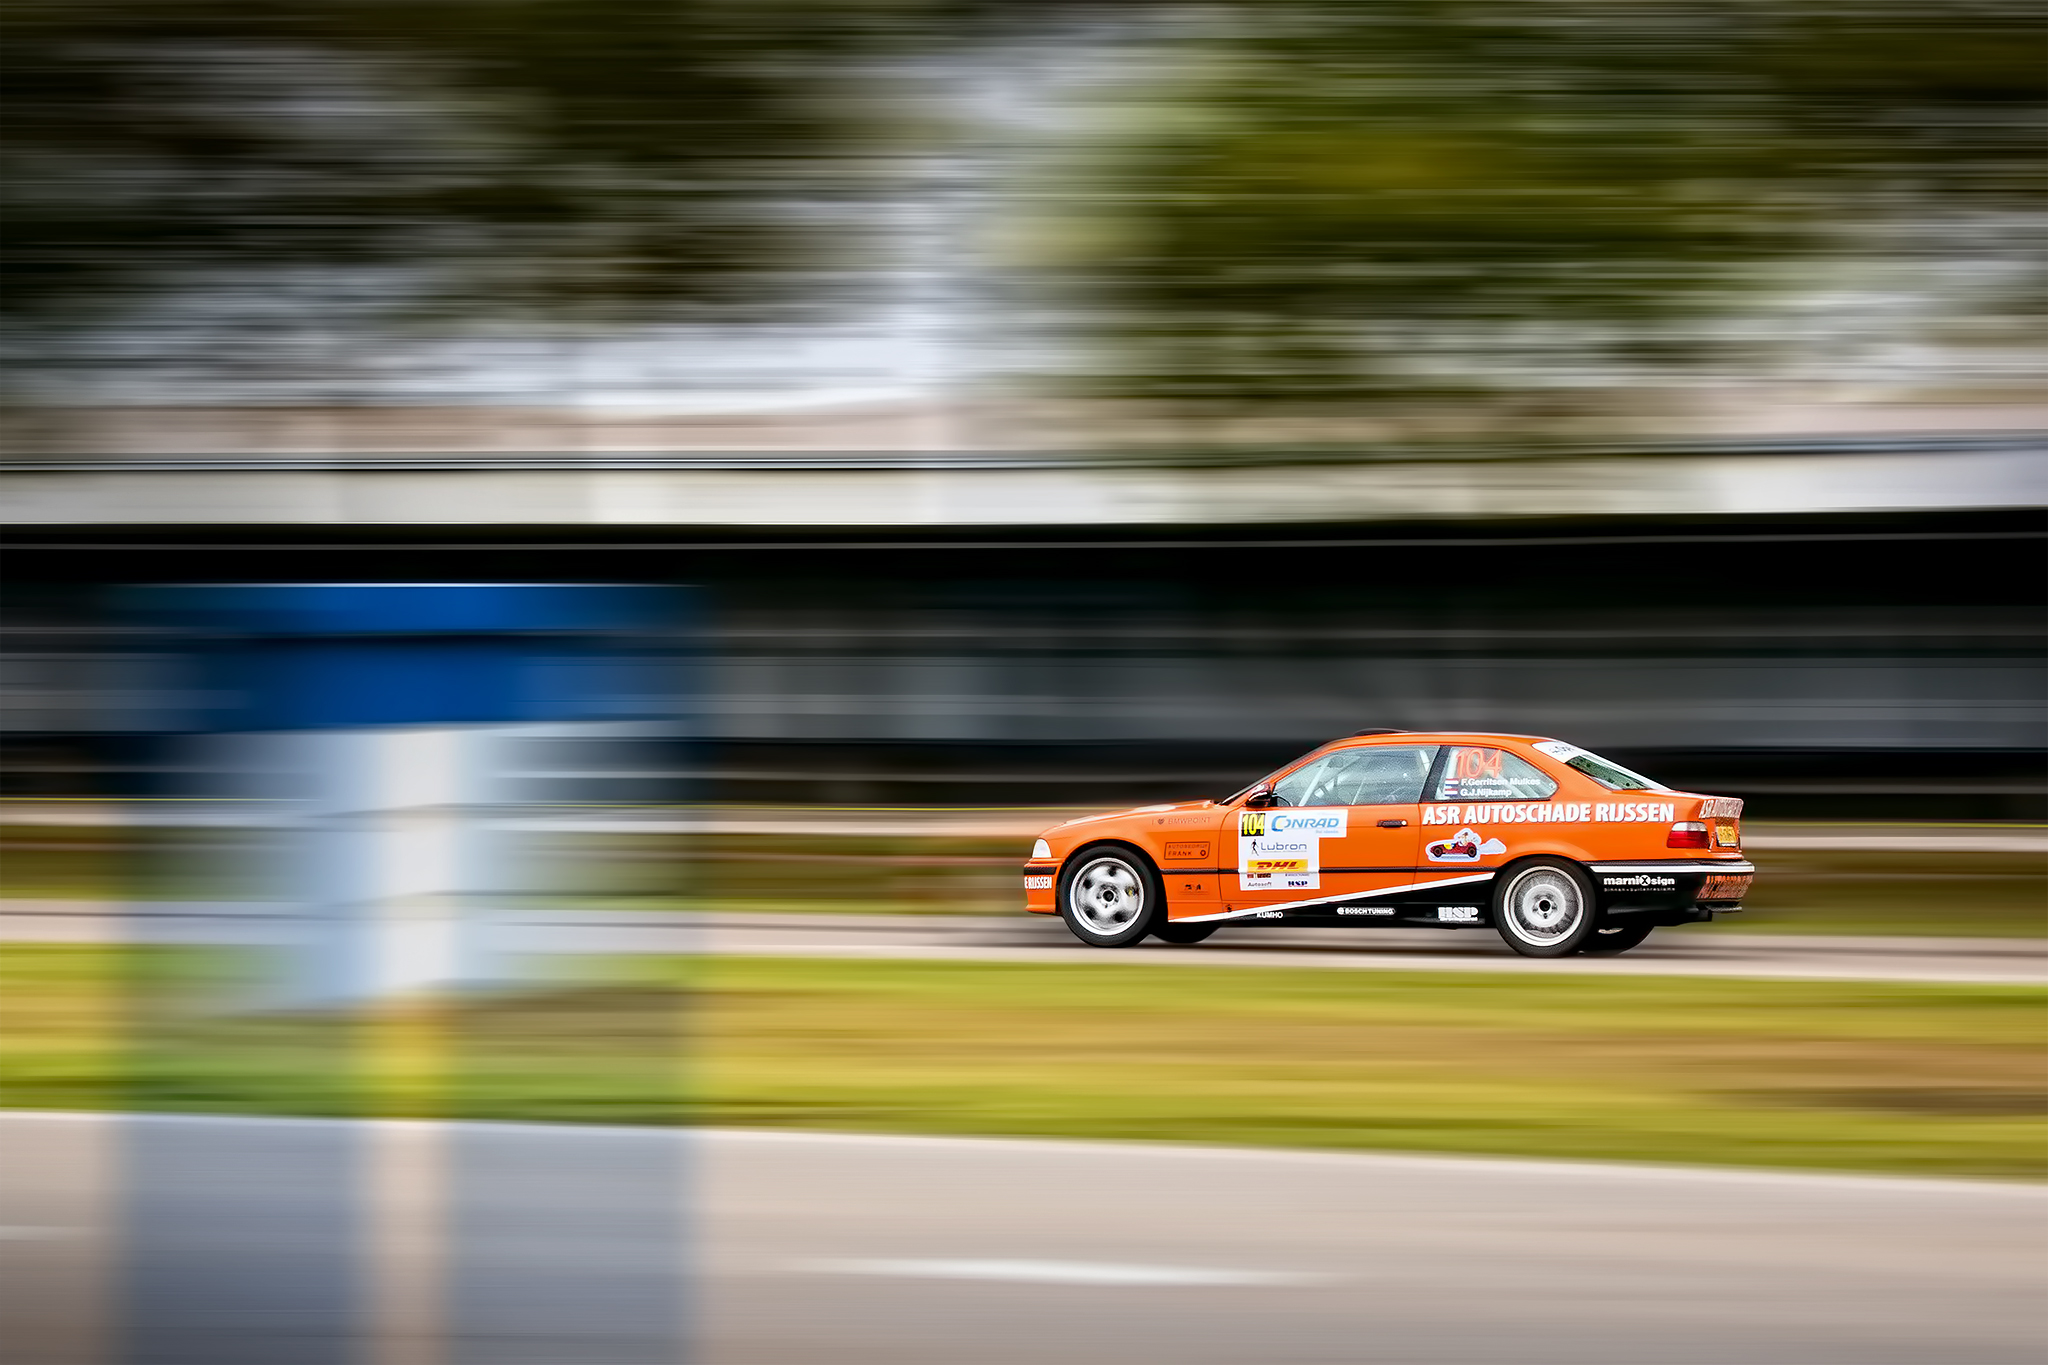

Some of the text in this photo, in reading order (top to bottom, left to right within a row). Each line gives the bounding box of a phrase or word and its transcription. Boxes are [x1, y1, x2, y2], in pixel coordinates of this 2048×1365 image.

[1456, 748, 1502, 778] 104
[1422, 803, 1675, 825] ASR AUTOSCHADE RIJSSEN
[1242, 813, 1266, 836] 104
[1271, 815, 1340, 833] CONRAD
[1260, 842, 1308, 851] Lubron
[1256, 861, 1300, 870] DHL
[1256, 911, 1284, 919] KUMHO
